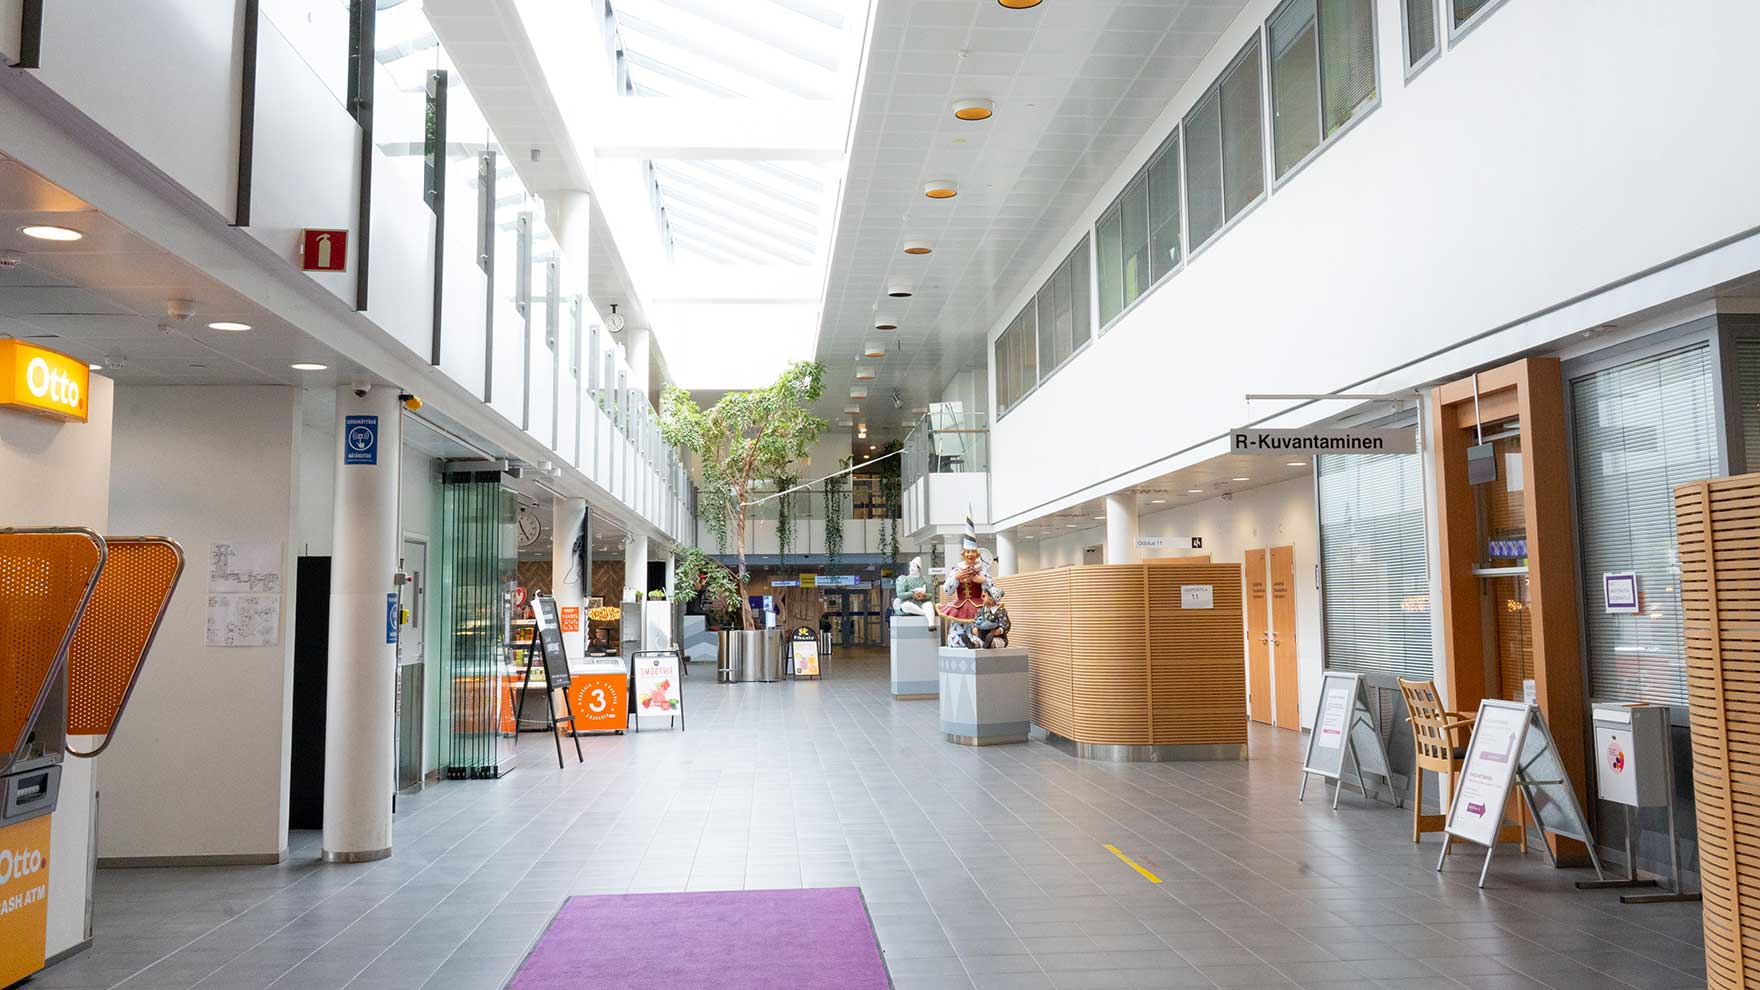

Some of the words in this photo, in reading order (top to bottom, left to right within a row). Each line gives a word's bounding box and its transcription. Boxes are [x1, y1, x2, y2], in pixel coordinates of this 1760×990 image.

[1235, 434, 1383, 450] R-Kuvantaminen
[588, 688, 607, 713] 3
[0, 893, 22, 915] ASH
[24, 884, 46, 906] ATM
